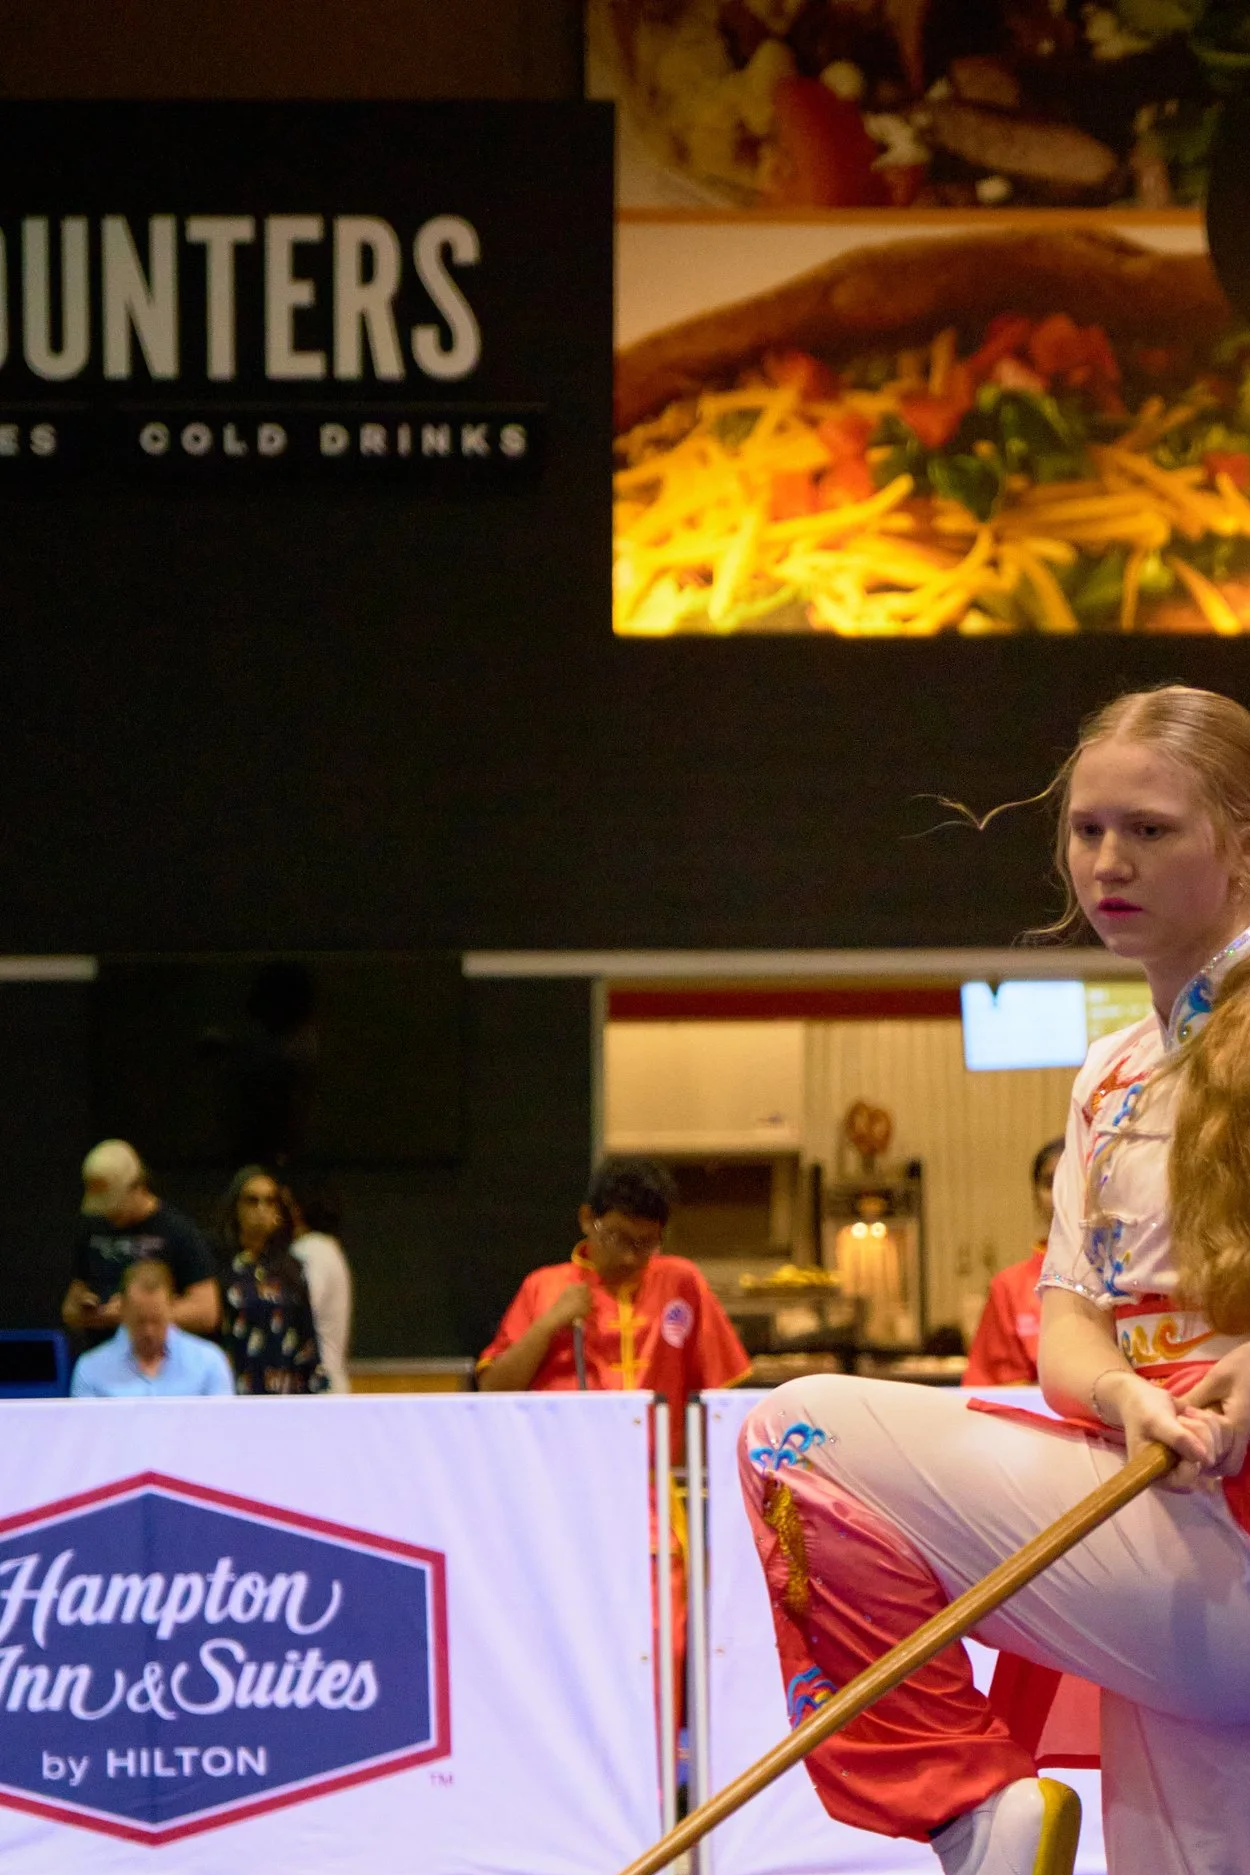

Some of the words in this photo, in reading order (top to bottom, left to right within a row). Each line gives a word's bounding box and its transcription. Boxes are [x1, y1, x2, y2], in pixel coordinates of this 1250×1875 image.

[0, 214, 482, 381] UNTERS
[139, 424, 287, 457] COLD
[320, 424, 528, 458] DRINKS
[0, 1549, 343, 1650] Hampton
[127, 1661, 178, 1721] &
[171, 1637, 379, 1715] Suites
[42, 1750, 89, 1787] by
[106, 1746, 268, 1778] HILTON
